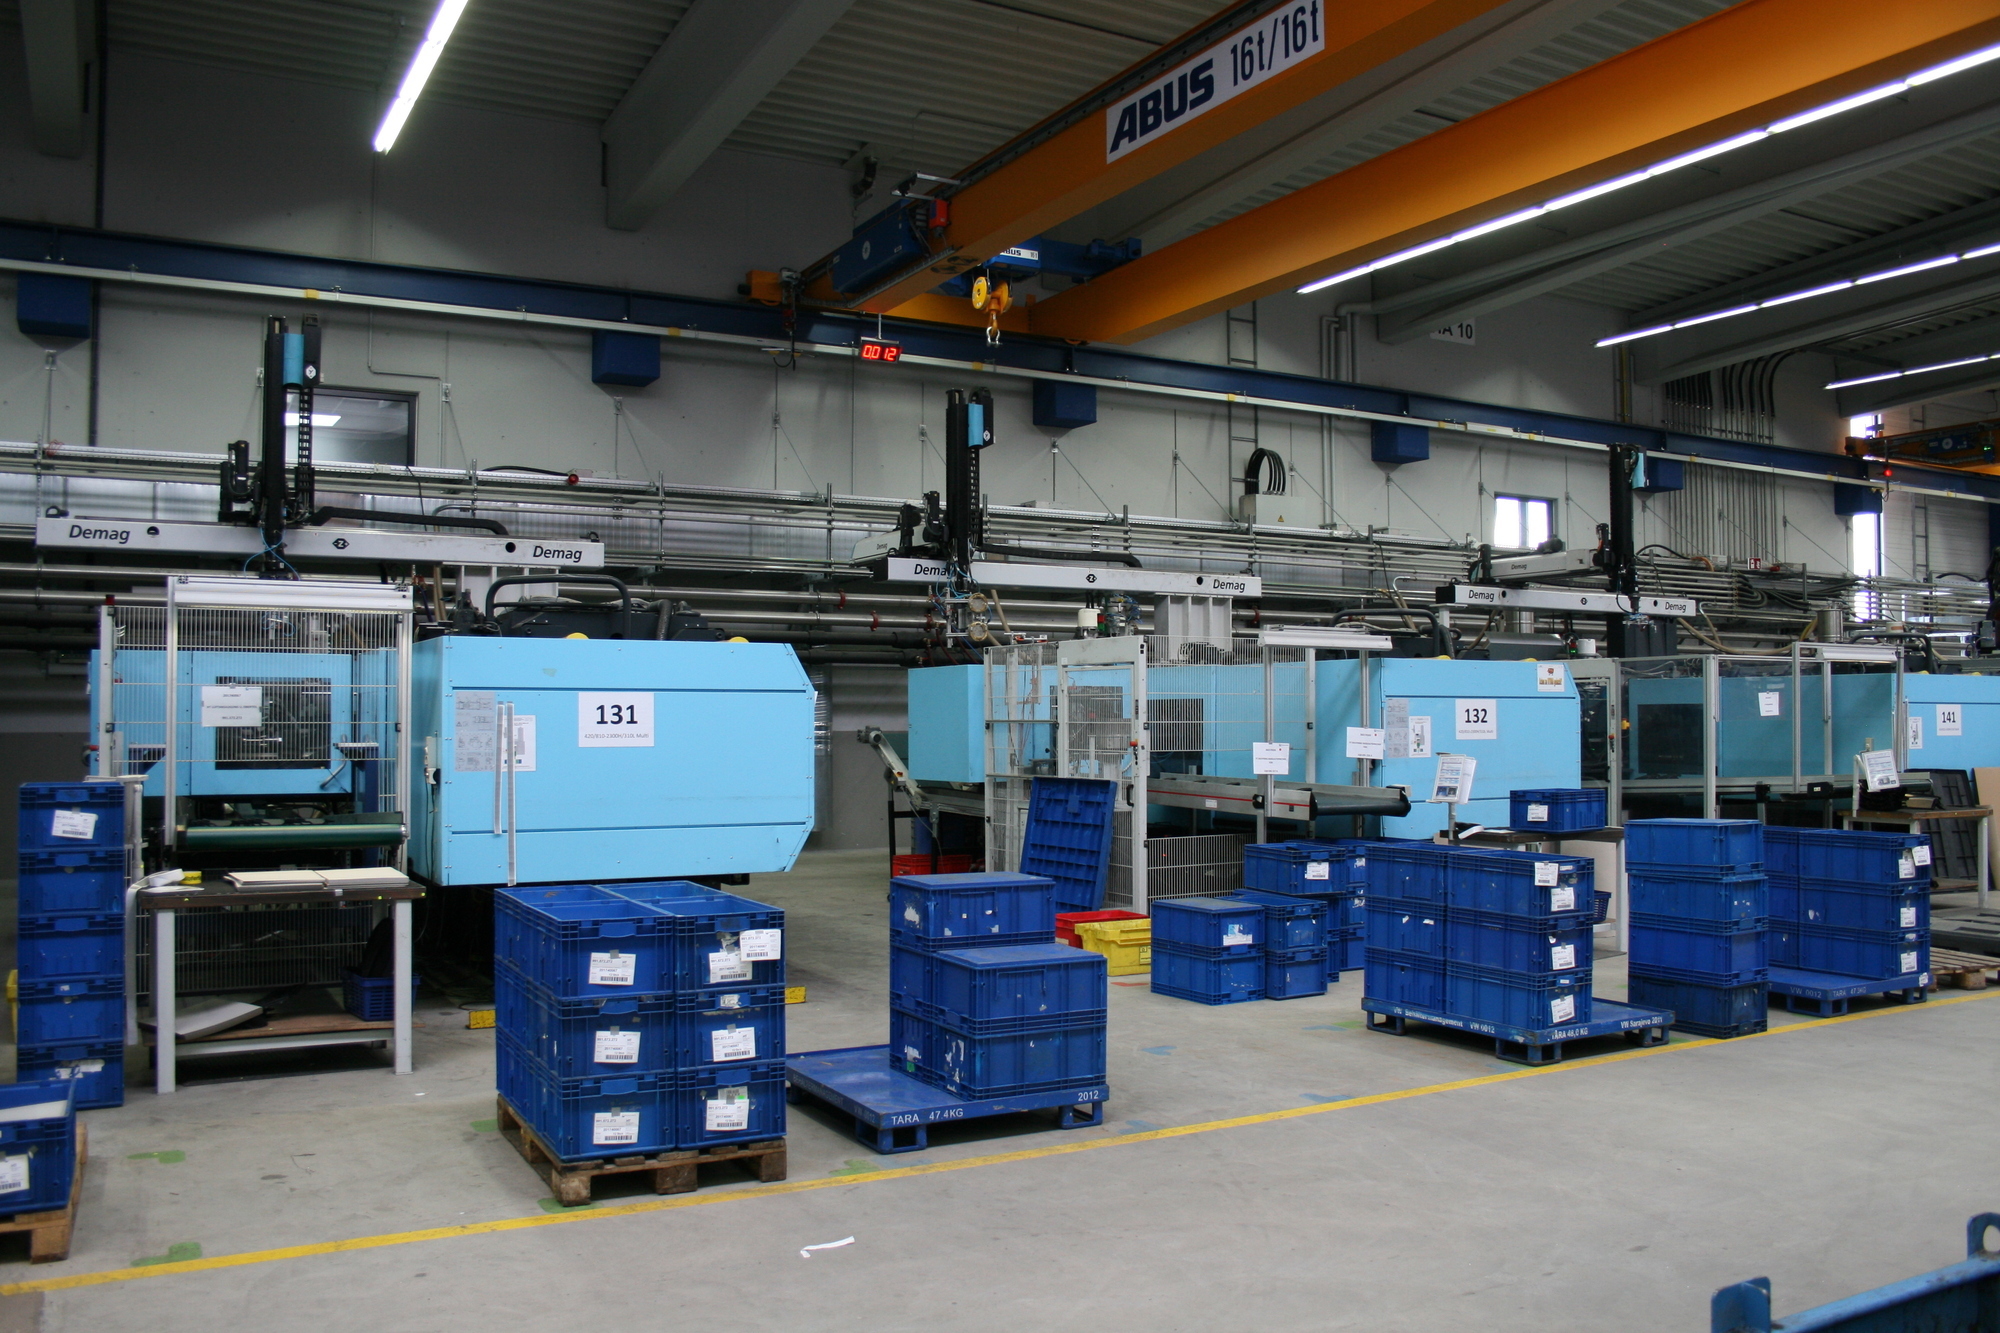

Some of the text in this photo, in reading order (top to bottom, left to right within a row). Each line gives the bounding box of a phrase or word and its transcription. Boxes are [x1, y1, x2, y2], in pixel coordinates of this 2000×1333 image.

[1109, 0, 1319, 154] ABUS 16t/16t
[1003, 249, 1022, 257] BUS
[1458, 322, 1473, 339] 10
[69, 524, 131, 544] Demag
[532, 545, 583, 563] Demag
[913, 563, 951, 579] Dema
[1510, 562, 1528, 571] Demag
[1212, 578, 1246, 593] Demag
[1468, 589, 1495, 602] Demag
[1664, 601, 1687, 613] Demag
[595, 704, 639, 725] 131
[1464, 707, 1488, 724] 132
[1942, 711, 1956, 723] 141
[1790, 986, 1822, 999] VW 0012
[1833, 990, 1846, 998] TARA
[1470, 1021, 1480, 1031] VW
[1481, 1024, 1495, 1034] 0012
[1581, 1027, 1588, 1035] KG
[1621, 1021, 1629, 1029] VW
[1078, 1090, 1099, 1102] 2012
[892, 1108, 964, 1126] TARA 47.4KG
